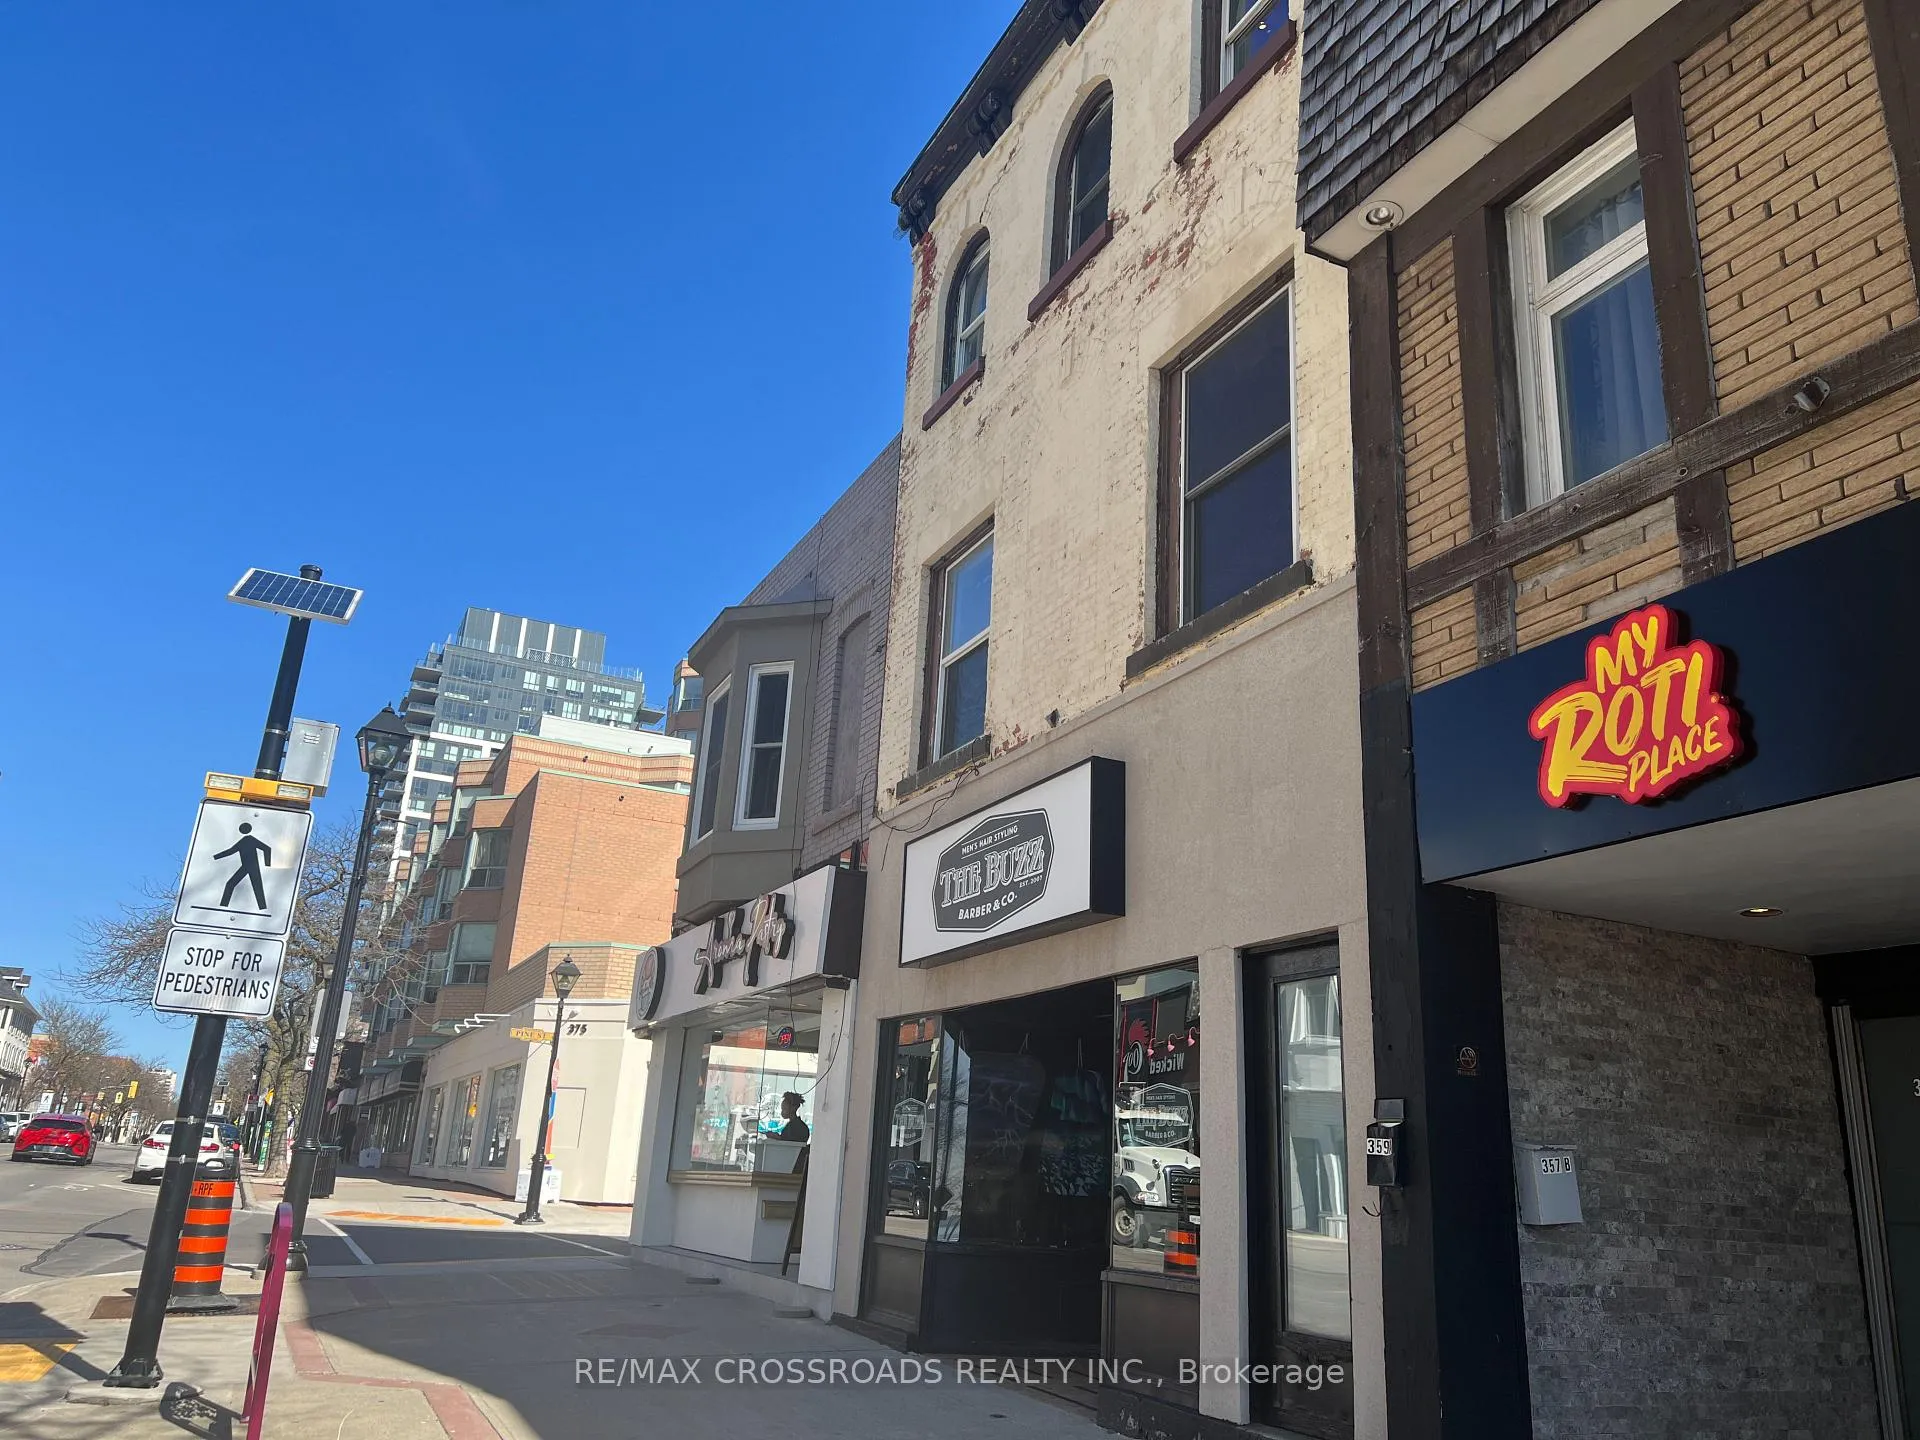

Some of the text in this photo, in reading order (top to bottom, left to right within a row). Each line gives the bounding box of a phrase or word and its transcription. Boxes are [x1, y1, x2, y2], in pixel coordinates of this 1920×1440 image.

[1595, 616, 1658, 693] MY
[1537, 652, 1703, 797] ROTI
[1628, 716, 1723, 792] PLACE
[961, 825, 1018, 855] MEN'S HAIR STYLING
[940, 835, 1044, 907] THE BUZZ
[184, 946, 263, 973] STOP FOR
[162, 972, 270, 1000] PEDESTRIANS
[566, 1024, 587, 1036] 375
[1367, 1139, 1390, 1155] 359
[1541, 1157, 1571, 1173] 357 B
